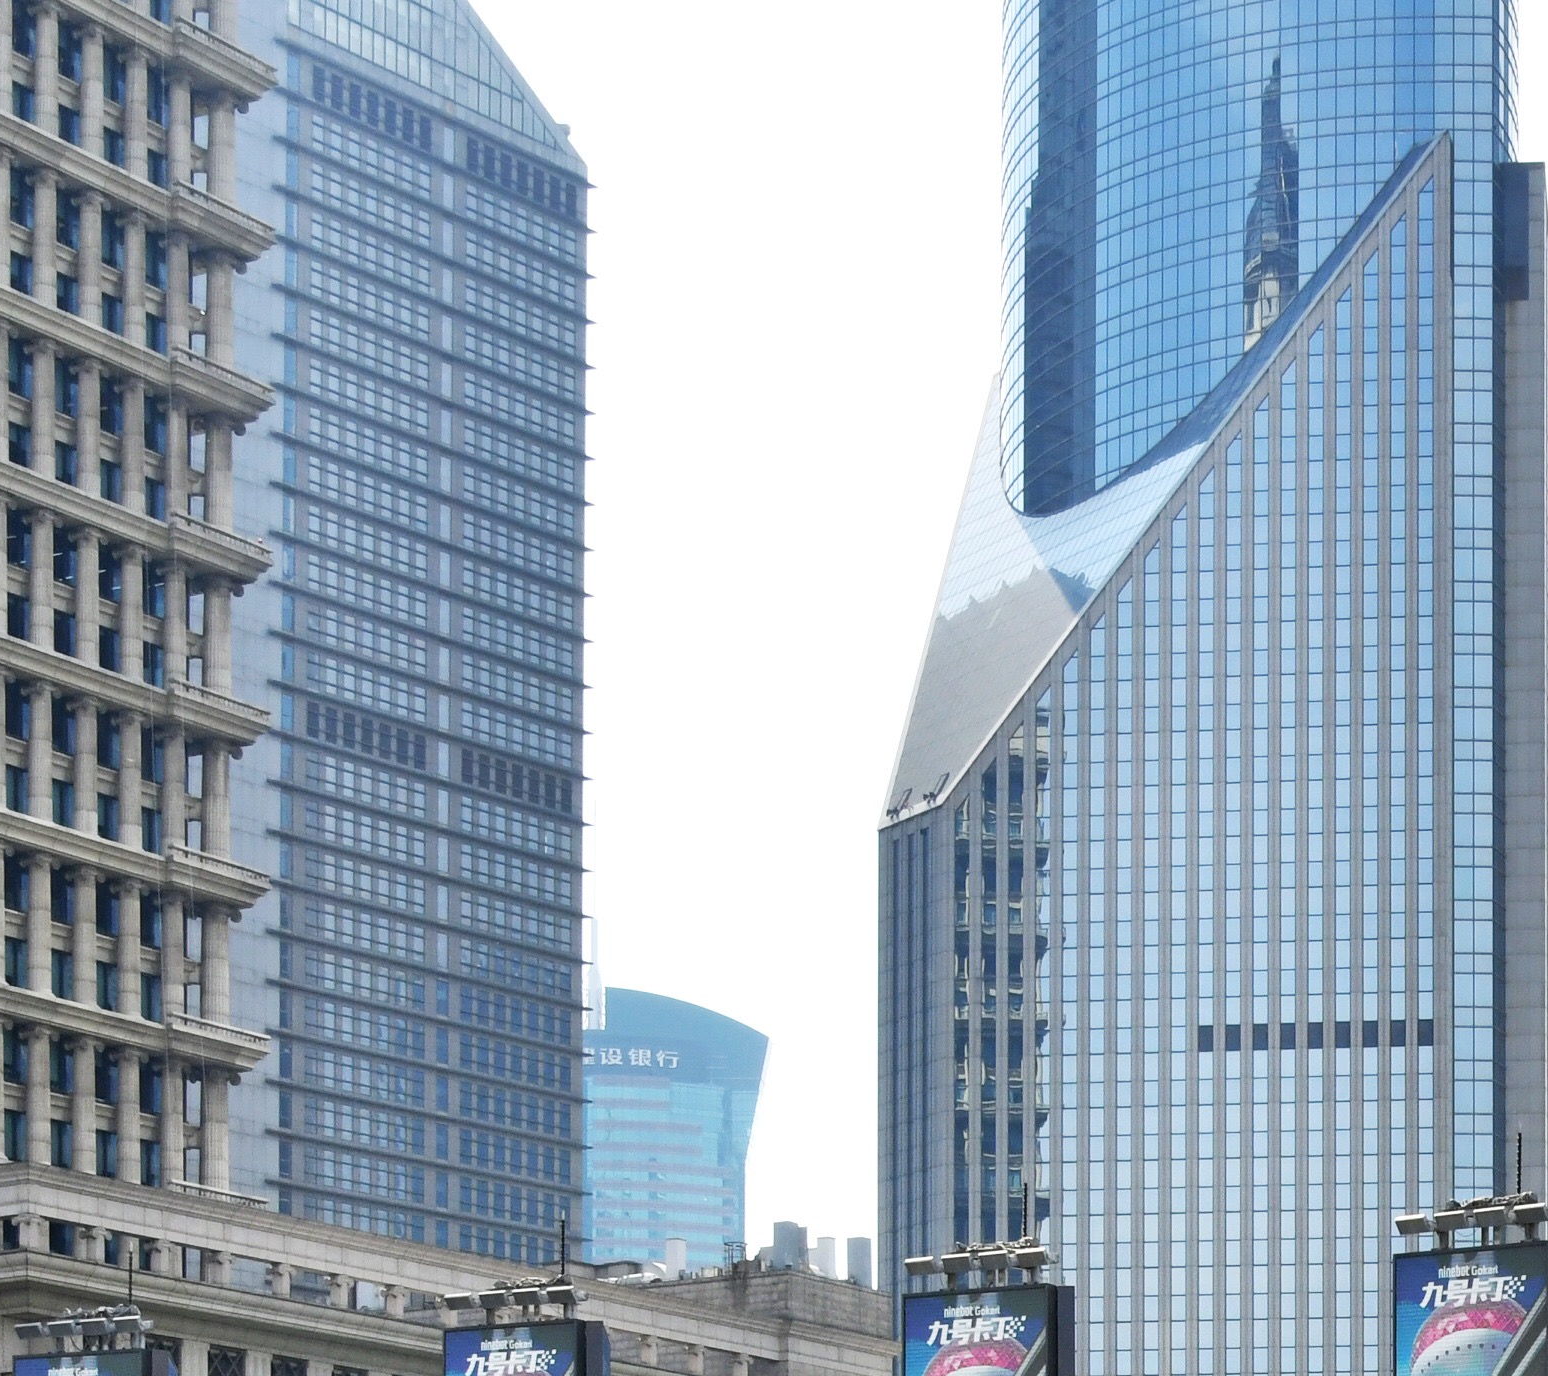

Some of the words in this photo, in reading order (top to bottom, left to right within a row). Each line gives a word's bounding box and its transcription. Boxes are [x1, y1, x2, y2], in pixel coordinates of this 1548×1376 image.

[1438, 1264, 1470, 1278] ninebot
[1420, 1276, 1512, 1307] 九号卡丁
[928, 1316, 1013, 1343] 九号卡丁
[465, 1349, 541, 1374] 九号卡丁
